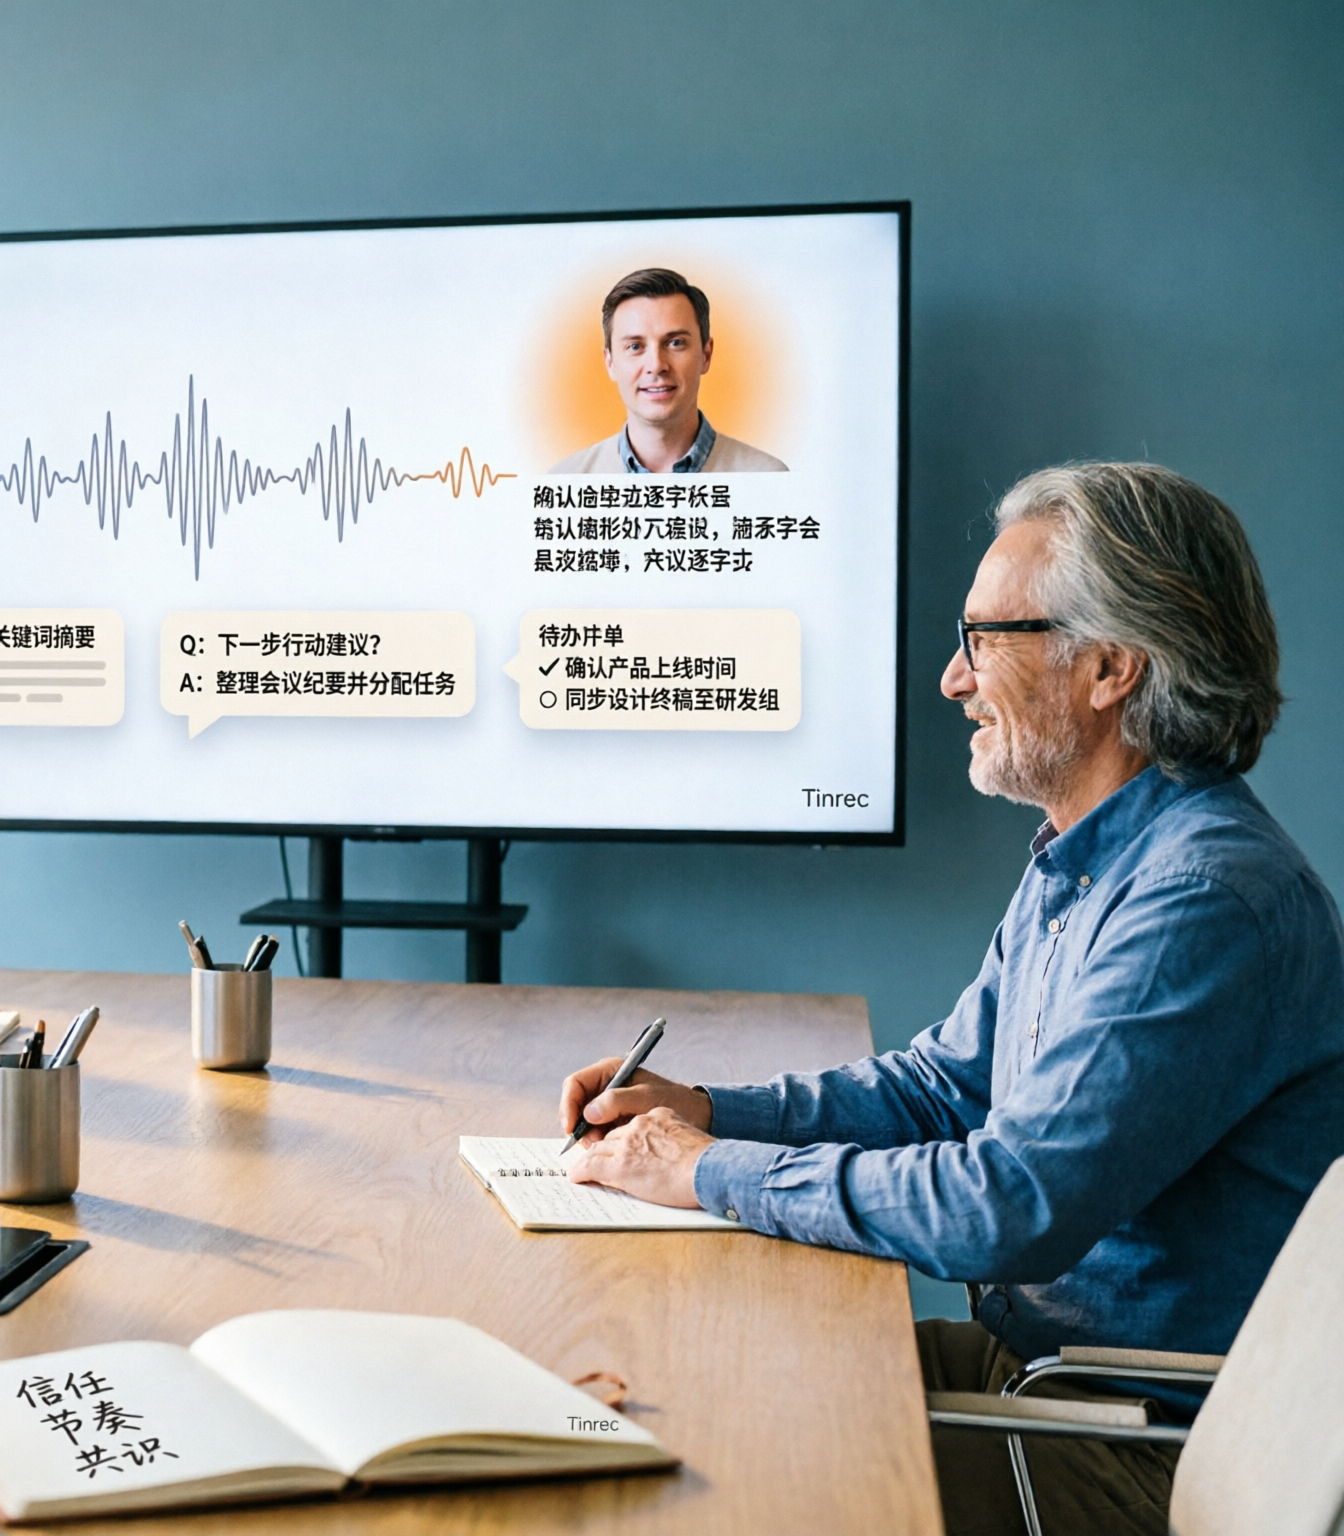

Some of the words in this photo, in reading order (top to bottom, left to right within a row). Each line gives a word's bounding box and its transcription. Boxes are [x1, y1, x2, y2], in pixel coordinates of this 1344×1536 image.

[565, 655, 736, 680] 确认产品上线时间
[565, 686, 780, 712] 同步设计终稿至研发组
[801, 788, 869, 808] Tinrec
[16, 1370, 114, 1409] 信任
[40, 1400, 144, 1446] 节奏
[567, 1416, 619, 1432] Tinrec
[75, 1437, 180, 1479] 共识
